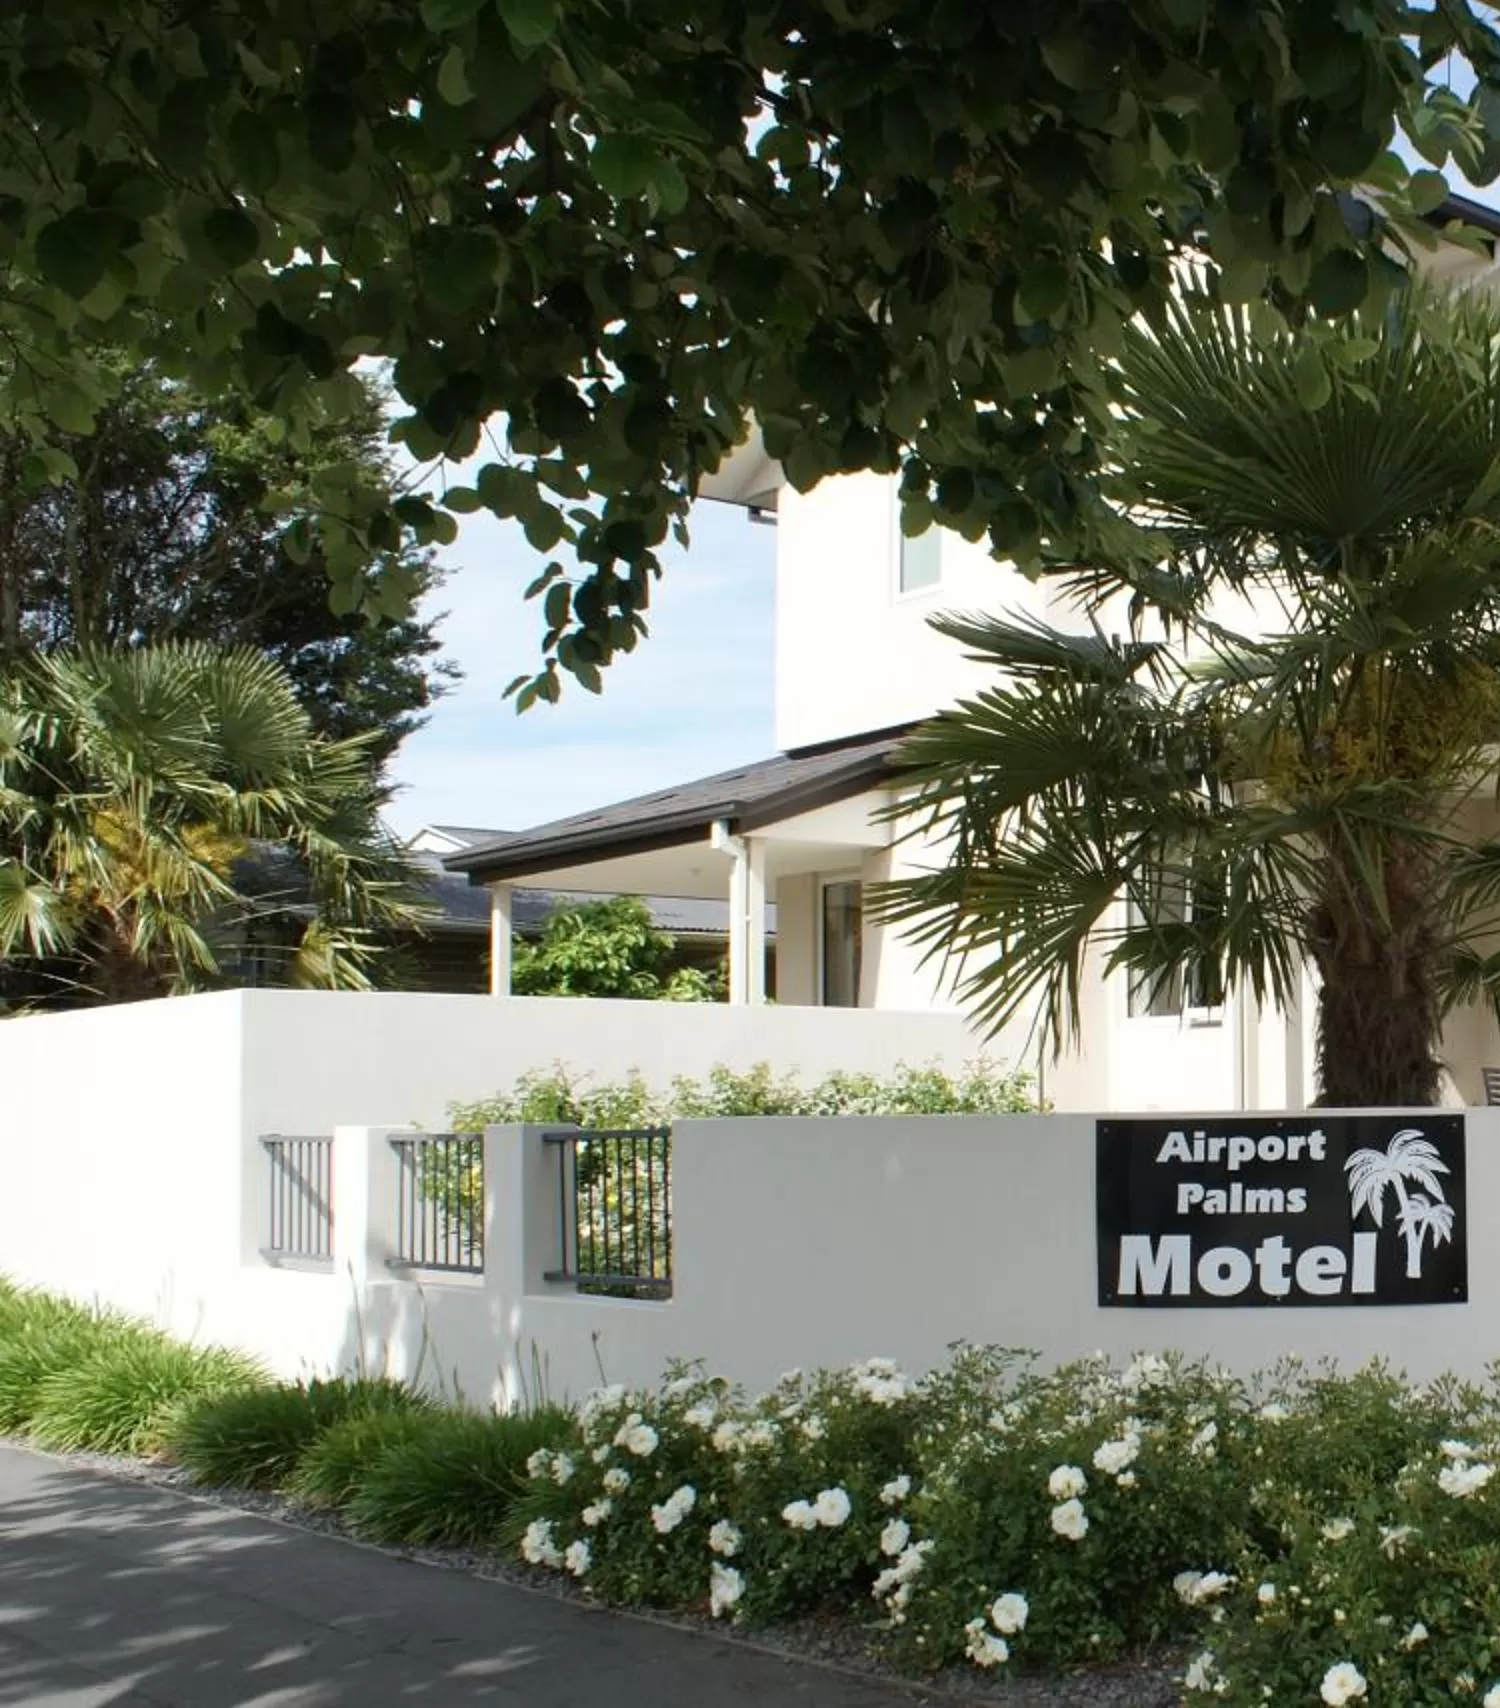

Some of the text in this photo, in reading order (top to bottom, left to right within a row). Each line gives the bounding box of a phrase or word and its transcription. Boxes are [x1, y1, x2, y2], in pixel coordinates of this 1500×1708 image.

[1155, 1128, 1327, 1171] Airport
[1176, 1182, 1308, 1215] Palms
[1116, 1230, 1378, 1298] Motel
